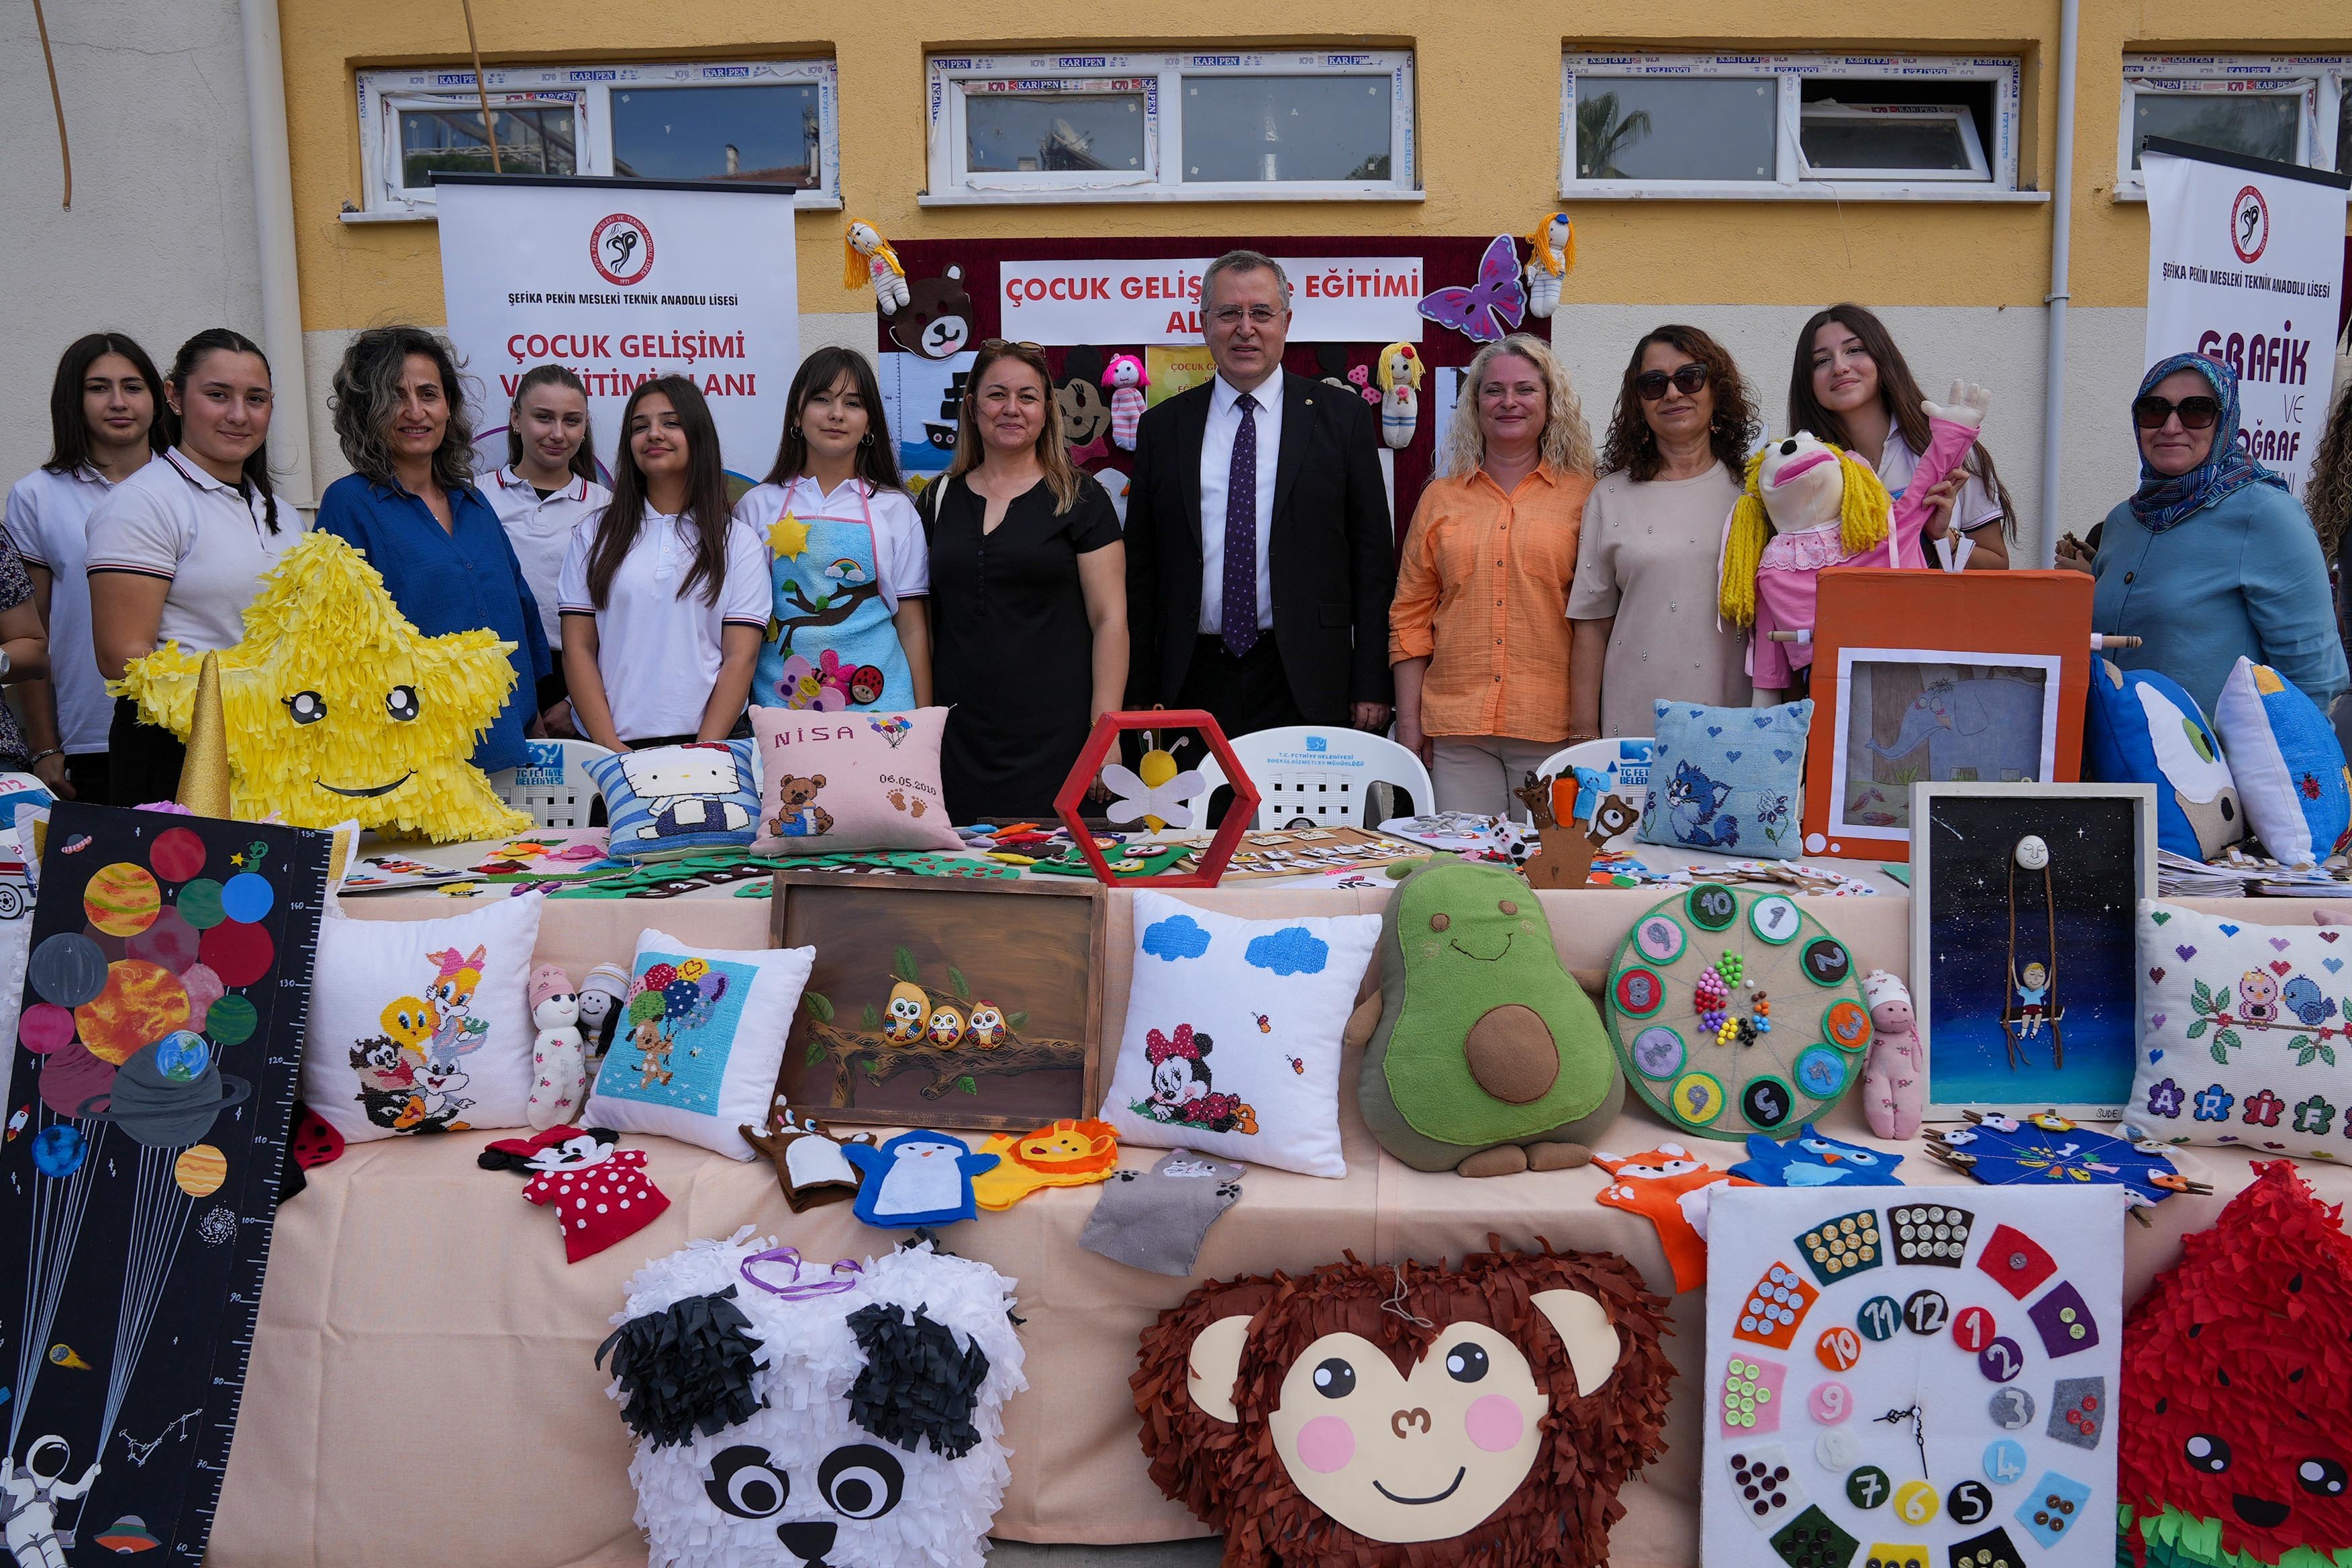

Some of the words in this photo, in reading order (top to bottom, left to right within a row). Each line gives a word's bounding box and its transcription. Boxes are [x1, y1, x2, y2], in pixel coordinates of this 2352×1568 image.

[950, 60, 970, 68] PEN
[1060, 58, 1080, 66] KAR
[1084, 58, 1104, 66] PEN
[1194, 57, 1214, 65] KAR
[1219, 56, 1239, 65] PEN
[1328, 56, 1349, 64] KAR
[438, 75, 459, 85] KAR
[571, 71, 591, 80] KAR
[595, 71, 615, 80] PEN
[703, 68, 724, 77] KAR
[728, 67, 748, 77] PEN
[932, 84, 940, 103] PEN
[988, 82, 1006, 91] K70
[1018, 81, 1038, 89] KAR
[1040, 81, 1061, 89] PEN
[1112, 81, 1129, 90] K70
[2161, 81, 2180, 89] PEN
[2228, 82, 2244, 91] K70
[2255, 81, 2273, 89] KAR
[556, 92, 575, 101] PEN
[1148, 93, 1157, 113] PEN
[644, 232, 653, 257] ANADOLU
[1006, 277, 1111, 307] ÇOCUK
[1120, 269, 1202, 304] GELİŞ
[1306, 268, 1418, 298] EĞİTİMİ
[2163, 260, 2186, 281] ŞEFİKA
[2189, 264, 2208, 283] PEKİN
[2210, 271, 2242, 288] MESLEKİ
[2245, 273, 2271, 291] TEKNİK
[2271, 278, 2306, 296] ANADOLU
[2307, 280, 2331, 299] LİSESİ
[508, 290, 542, 306] ŞEFİKA
[546, 291, 575, 304] PEKİN
[579, 291, 621, 305] MESLEKİ
[623, 292, 658, 305] TEKNİK
[660, 294, 706, 306] ANADOLU
[709, 293, 738, 306] LİSESİ
[507, 334, 612, 364] ÇOCUK
[620, 329, 746, 364] GELİŞİMİ
[1170, 363, 1204, 373] ÇOCUK
[2284, 394, 2305, 423] VE
[774, 726, 854, 748] NİSA
[879, 774, 937, 796] 06.05.2010
[300, 830, 316, 838] 150
[290, 901, 304, 910] 140
[1700, 891, 1732, 916] 10
[1767, 905, 1787, 930] 1
[1647, 922, 1671, 952] 9
[1814, 946, 1846, 972] 2
[279, 979, 296, 988] 130
[1628, 975, 1651, 1007] 8
[1837, 1010, 1865, 1040] 3
[268, 1056, 284, 1065] 120
[1807, 1059, 1832, 1085] 4
[1754, 1087, 1780, 1120] 5
[2096, 1108, 2118, 1118] SUDE
[2154, 1087, 2323, 1129] ARİF
[254, 1136, 268, 1144] 110
[242, 1216, 256, 1225] 100
[230, 1292, 242, 1303] 90
[1864, 1299, 1898, 1339] 11
[1910, 1294, 1946, 1330] 12
[1965, 1311, 1981, 1349] 1
[1822, 1330, 1857, 1370] 10
[1987, 1344, 2020, 1380] 2
[213, 1377, 225, 1386] 80
[1820, 1385, 1845, 1421] 9
[2004, 1390, 2028, 1429] 3
[1824, 1432, 1844, 1465] 8
[196, 1460, 209, 1469] 70
[1998, 1446, 2020, 1479] 4
[1855, 1473, 1882, 1508] 7
[1905, 1489, 1929, 1520] 6
[1960, 1484, 1983, 1520] 5
[176, 1543, 189, 1553] 60
